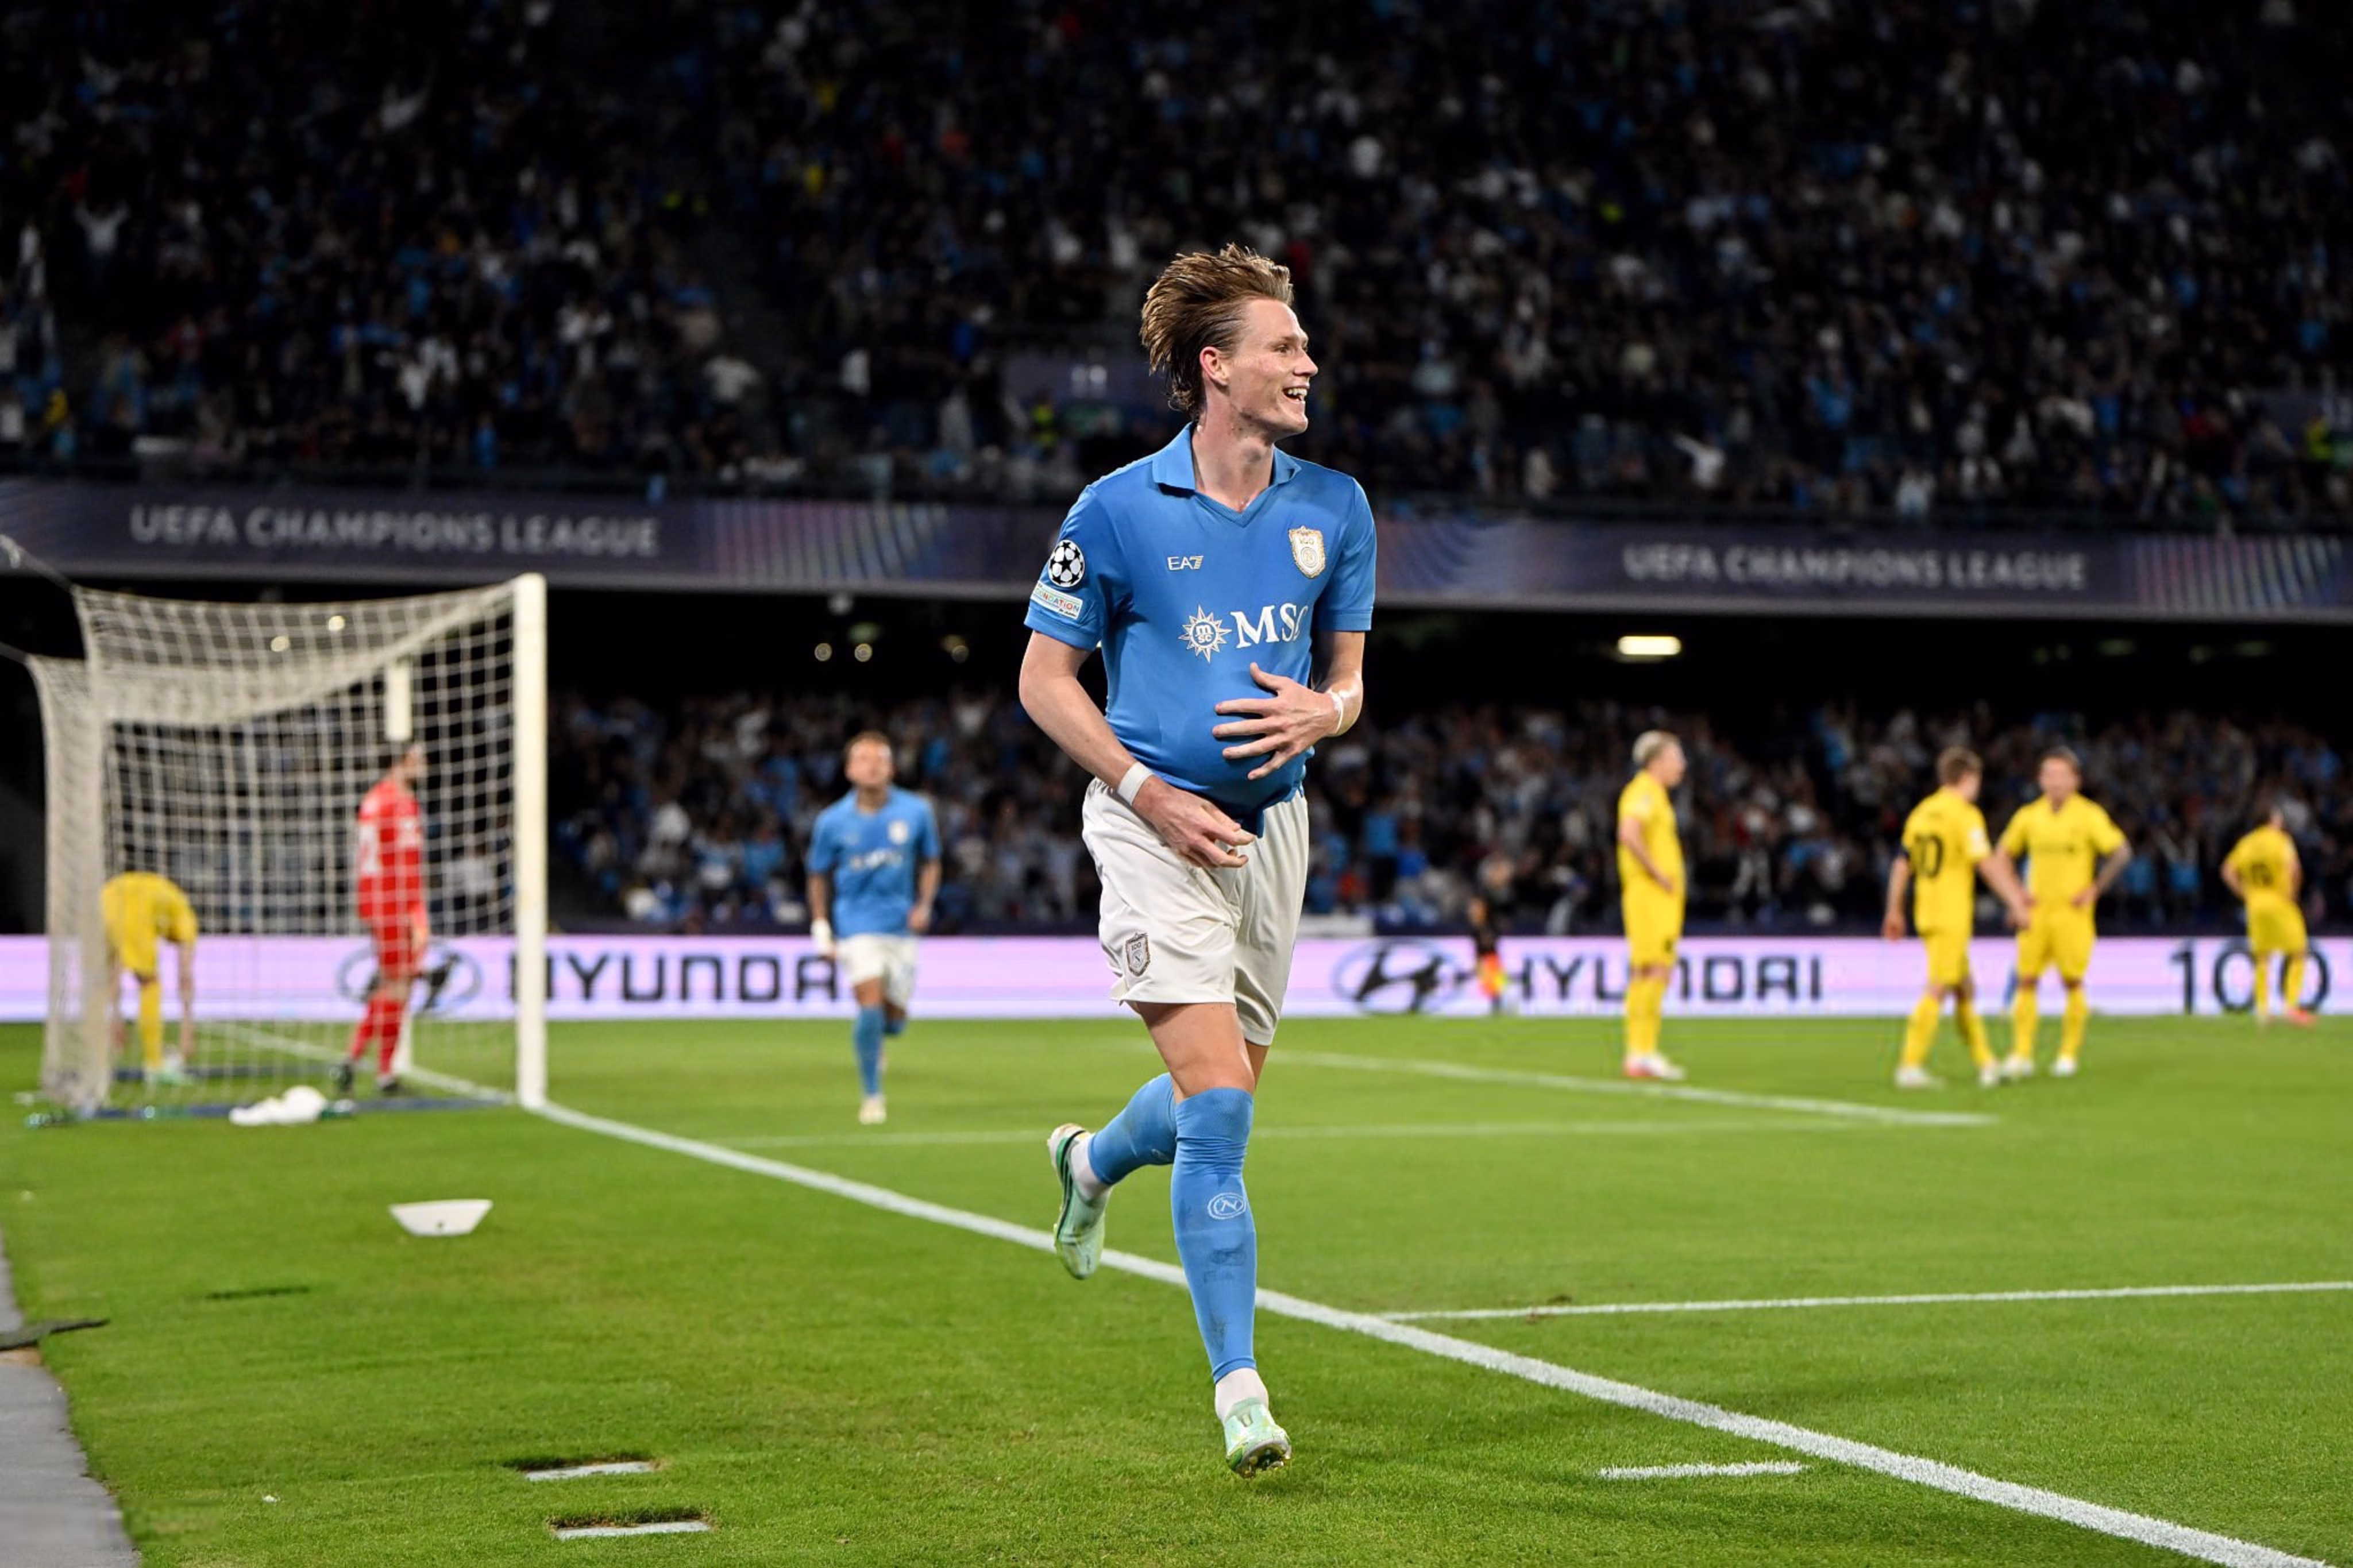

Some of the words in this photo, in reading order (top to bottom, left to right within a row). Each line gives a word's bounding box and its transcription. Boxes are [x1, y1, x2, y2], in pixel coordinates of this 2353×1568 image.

[128, 503, 237, 543] UEFA
[244, 505, 494, 553] CHAMPIONS
[500, 512, 659, 557] LEAGUE
[1167, 555, 1204, 570] EA7
[1623, 543, 1719, 582] UEFA
[1725, 546, 1943, 588] CHAMPIONS
[1948, 550, 2086, 590] LEAGUE
